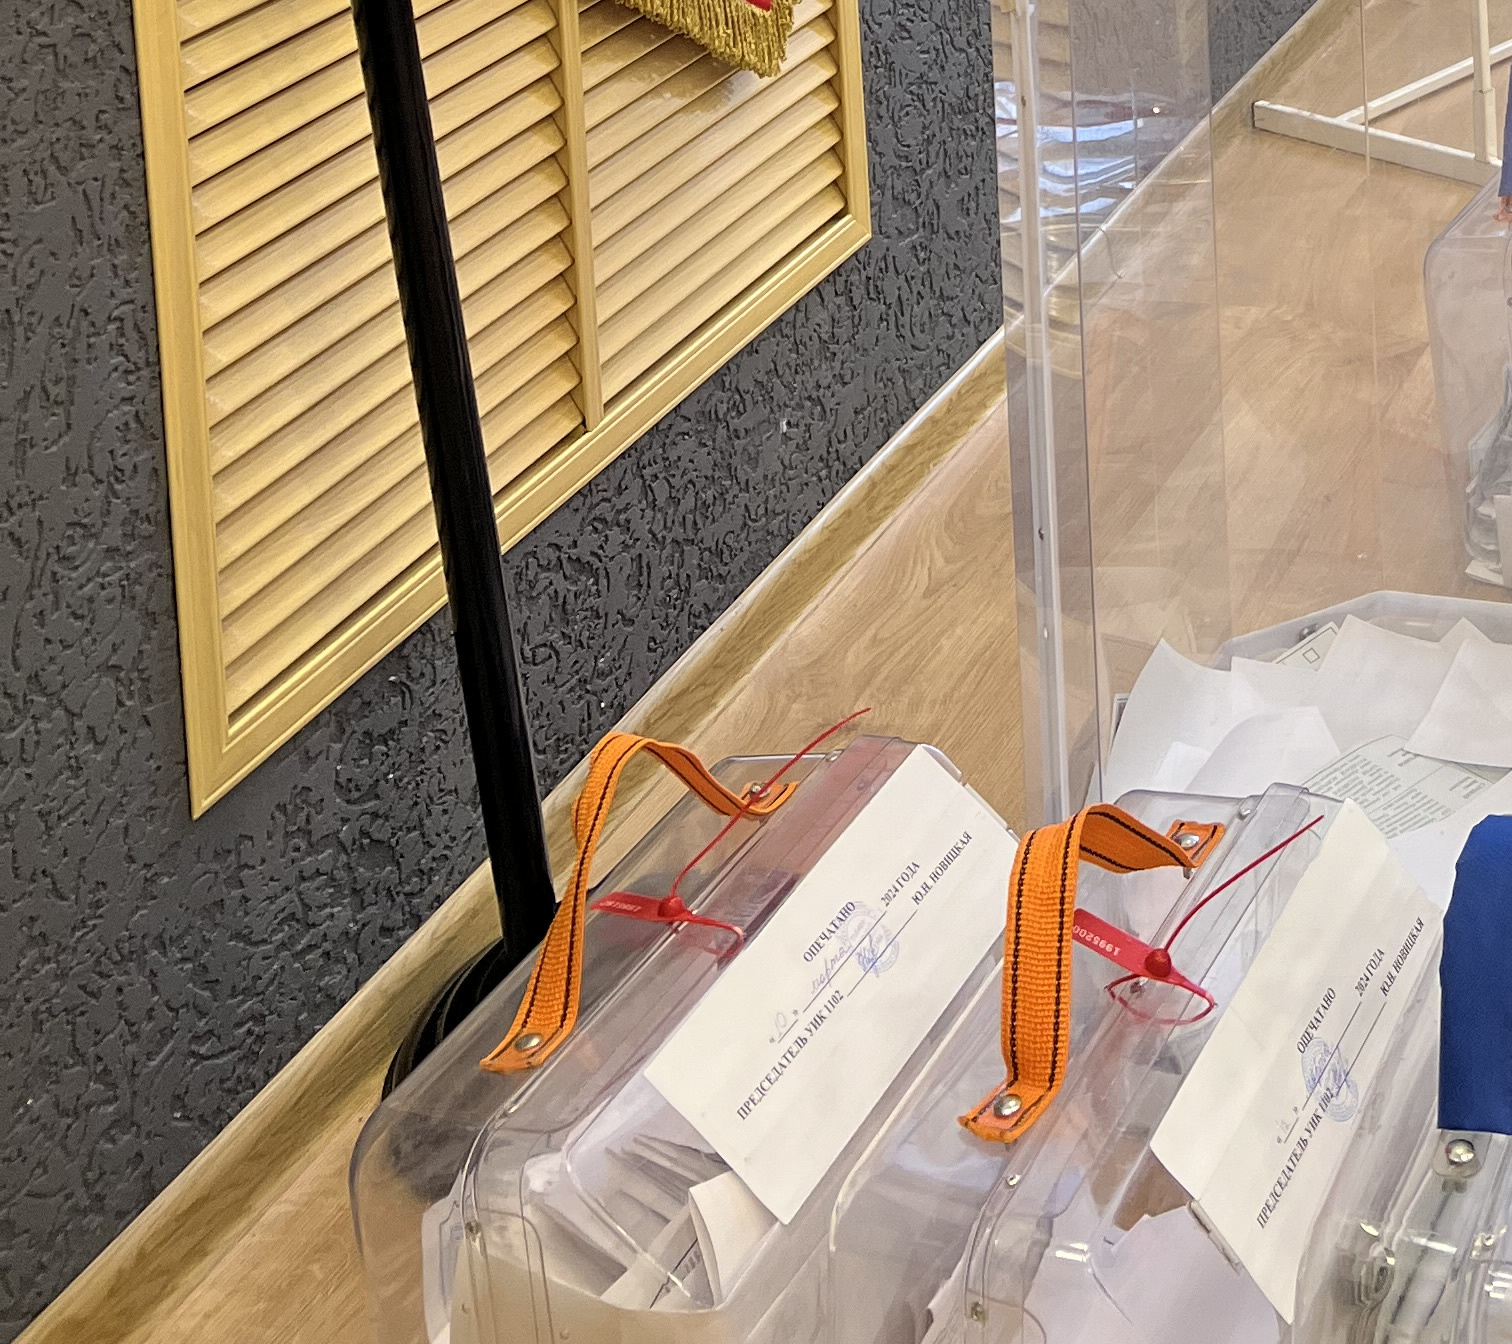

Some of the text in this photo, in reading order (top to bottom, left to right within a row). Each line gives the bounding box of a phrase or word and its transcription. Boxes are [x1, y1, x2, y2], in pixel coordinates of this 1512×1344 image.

[880, 884, 900, 908] 2024
[895, 861, 920, 890] ГОДА
[803, 901, 856, 963] ОПЕЧАТАНО
[1365, 948, 1385, 977] ГОДА
[736, 831, 973, 1121] ПРЕДСЕДАТЕЛЬ УИК 1102 Ю.Н. НОВИЦКАЯ
[1296, 987, 1337, 1054] ОПЕЧАТАНО
[1255, 1136, 1309, 1229] ПРЕДСЕДАТЕЛЬ
[1304, 1107, 1323, 1139] УИК
[1318, 1087, 1334, 1113] 1102
[1391, 916, 1425, 974] НОВИЦКАЯ
